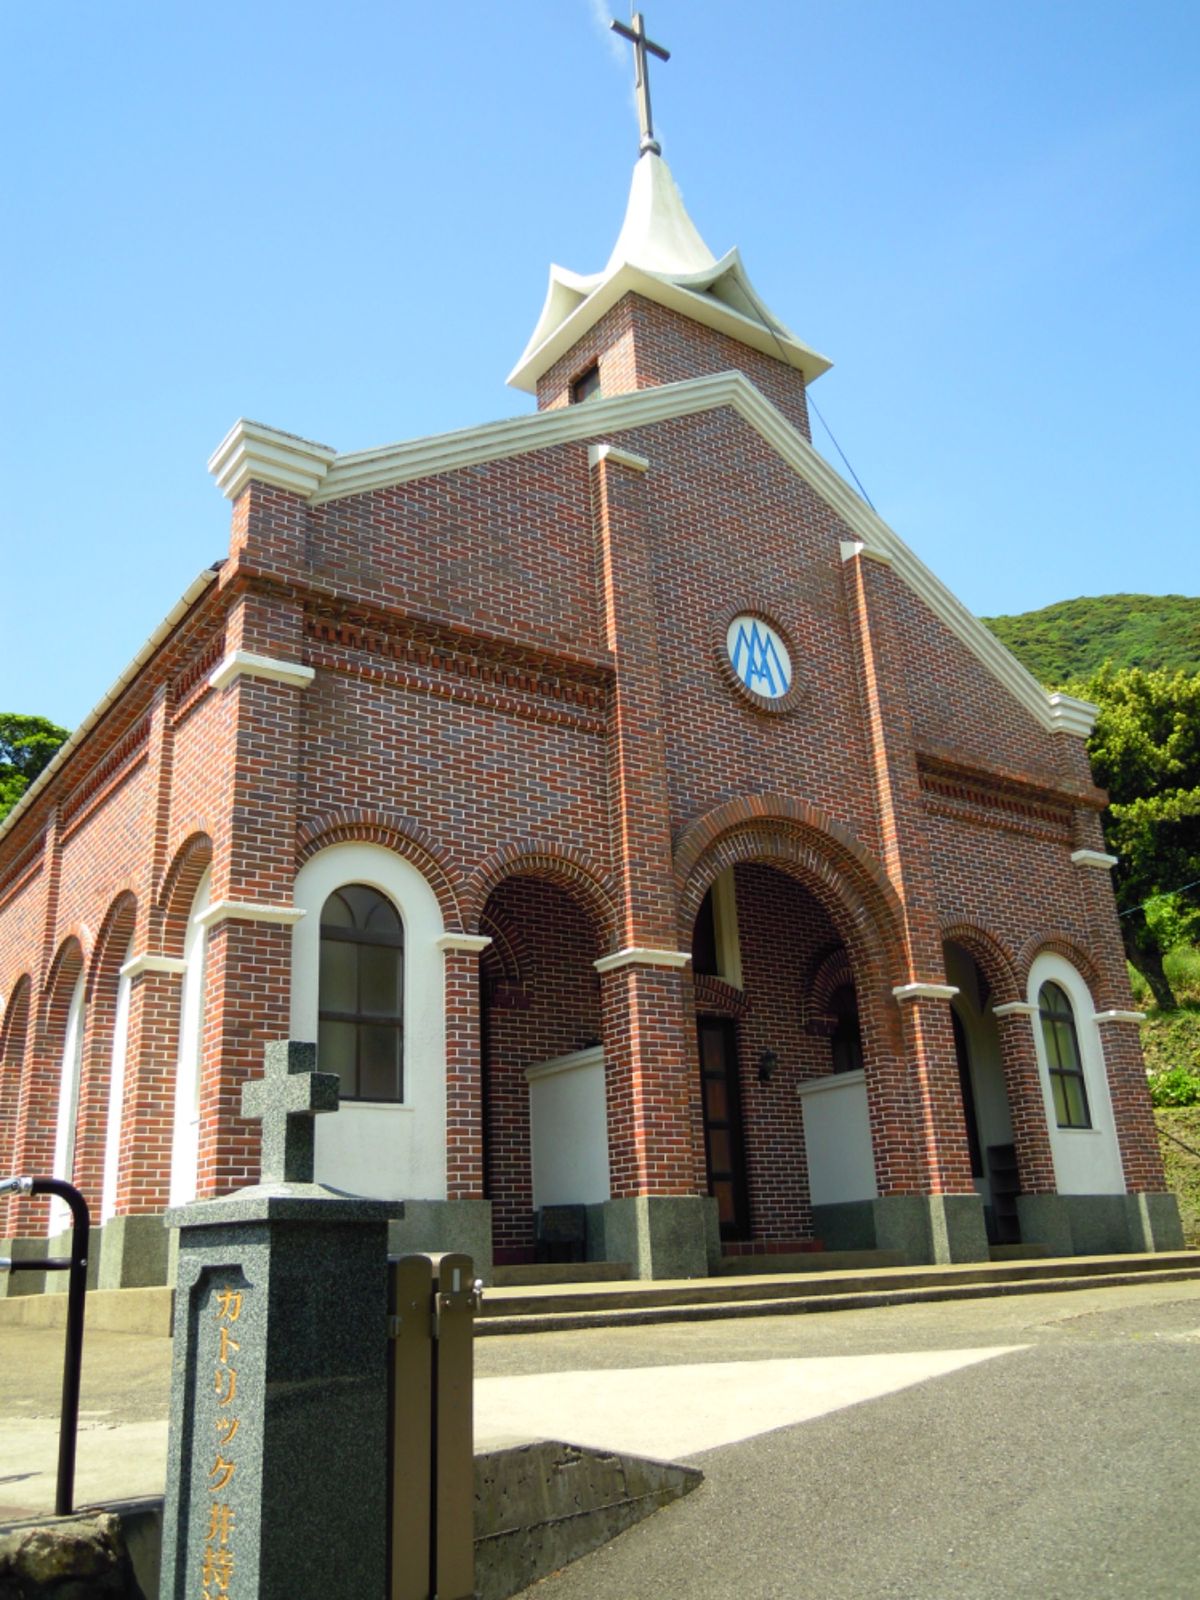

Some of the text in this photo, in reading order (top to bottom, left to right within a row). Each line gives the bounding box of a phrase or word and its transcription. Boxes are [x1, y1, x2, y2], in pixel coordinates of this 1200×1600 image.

[203, 1286, 242, 1600] カトリック井持
